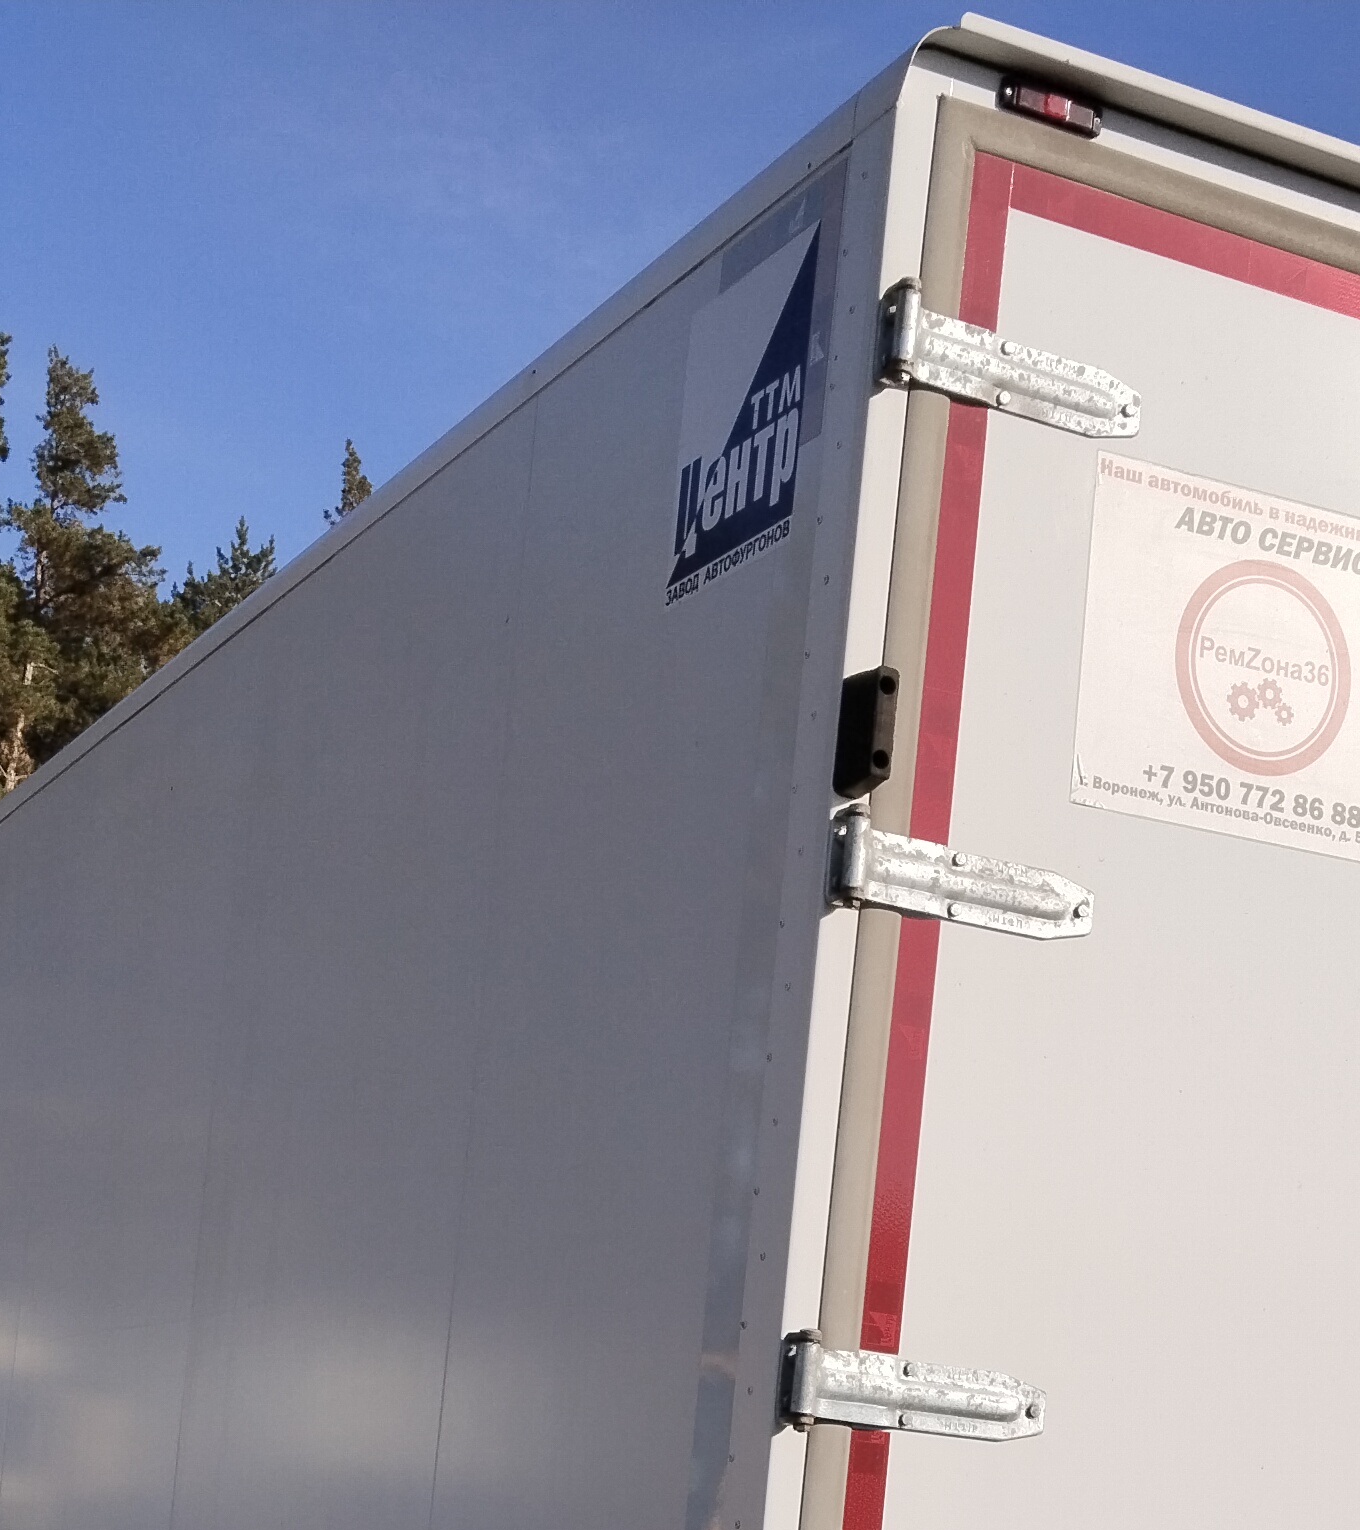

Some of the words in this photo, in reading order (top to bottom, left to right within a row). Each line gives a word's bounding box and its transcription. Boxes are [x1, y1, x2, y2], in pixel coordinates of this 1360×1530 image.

[750, 364, 801, 430] ТТМ
[1147, 474, 1265, 518] автомобиль
[1269, 505, 1280, 521] в
[1174, 506, 1252, 546] АВТО
[665, 573, 699, 607] ЗАВОД
[703, 519, 791, 585] АВТОФУРГОНОВ
[1198, 635, 1330, 688] РемZона36
[1142, 763, 1175, 789] +7
[1182, 769, 1231, 801] 950
[1239, 781, 1285, 813] 772
[1292, 793, 1324, 821] 86
